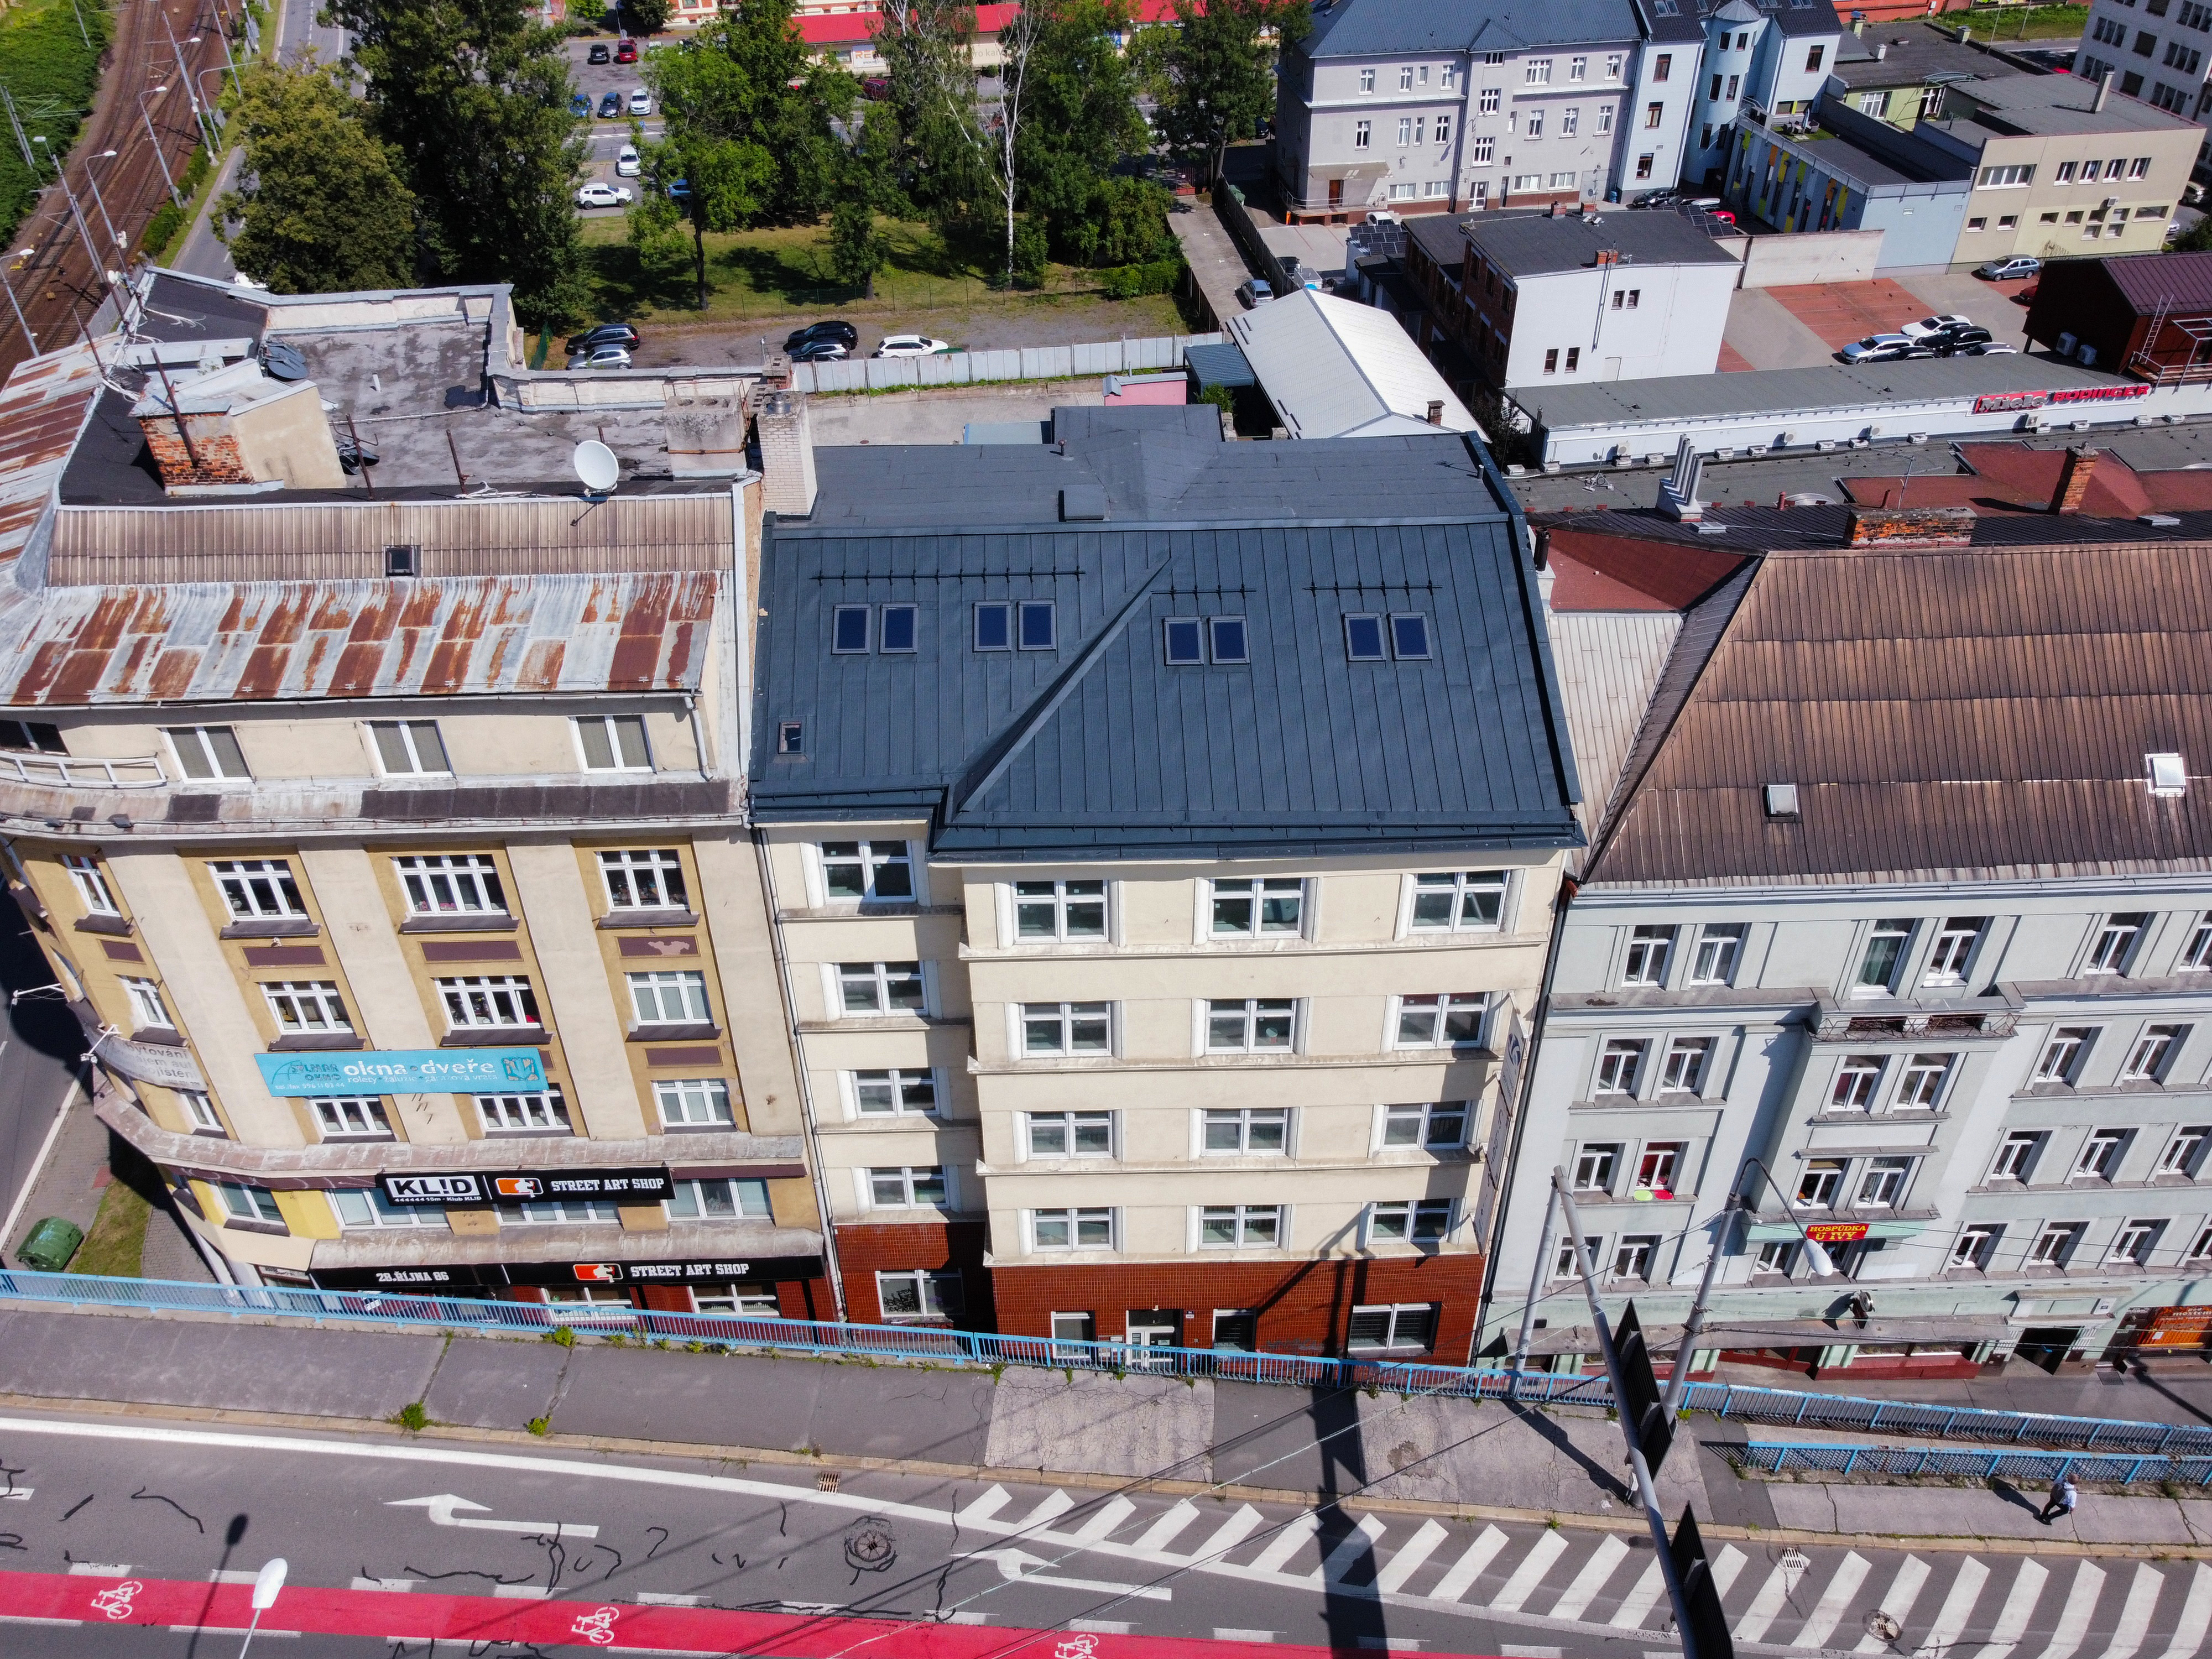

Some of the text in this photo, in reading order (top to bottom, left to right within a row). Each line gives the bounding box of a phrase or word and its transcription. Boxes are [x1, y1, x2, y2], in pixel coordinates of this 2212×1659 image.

[1979, 386, 2149, 411] Miele BODINGER
[343, 1058, 495, 1076] okna dveře
[393, 1178, 664, 1195] KL!D STREET ART SHOP
[1815, 1232, 1857, 1240] U IVY
[432, 1271, 450, 1281] 86
[630, 1263, 749, 1277] STREET ART SHOP
